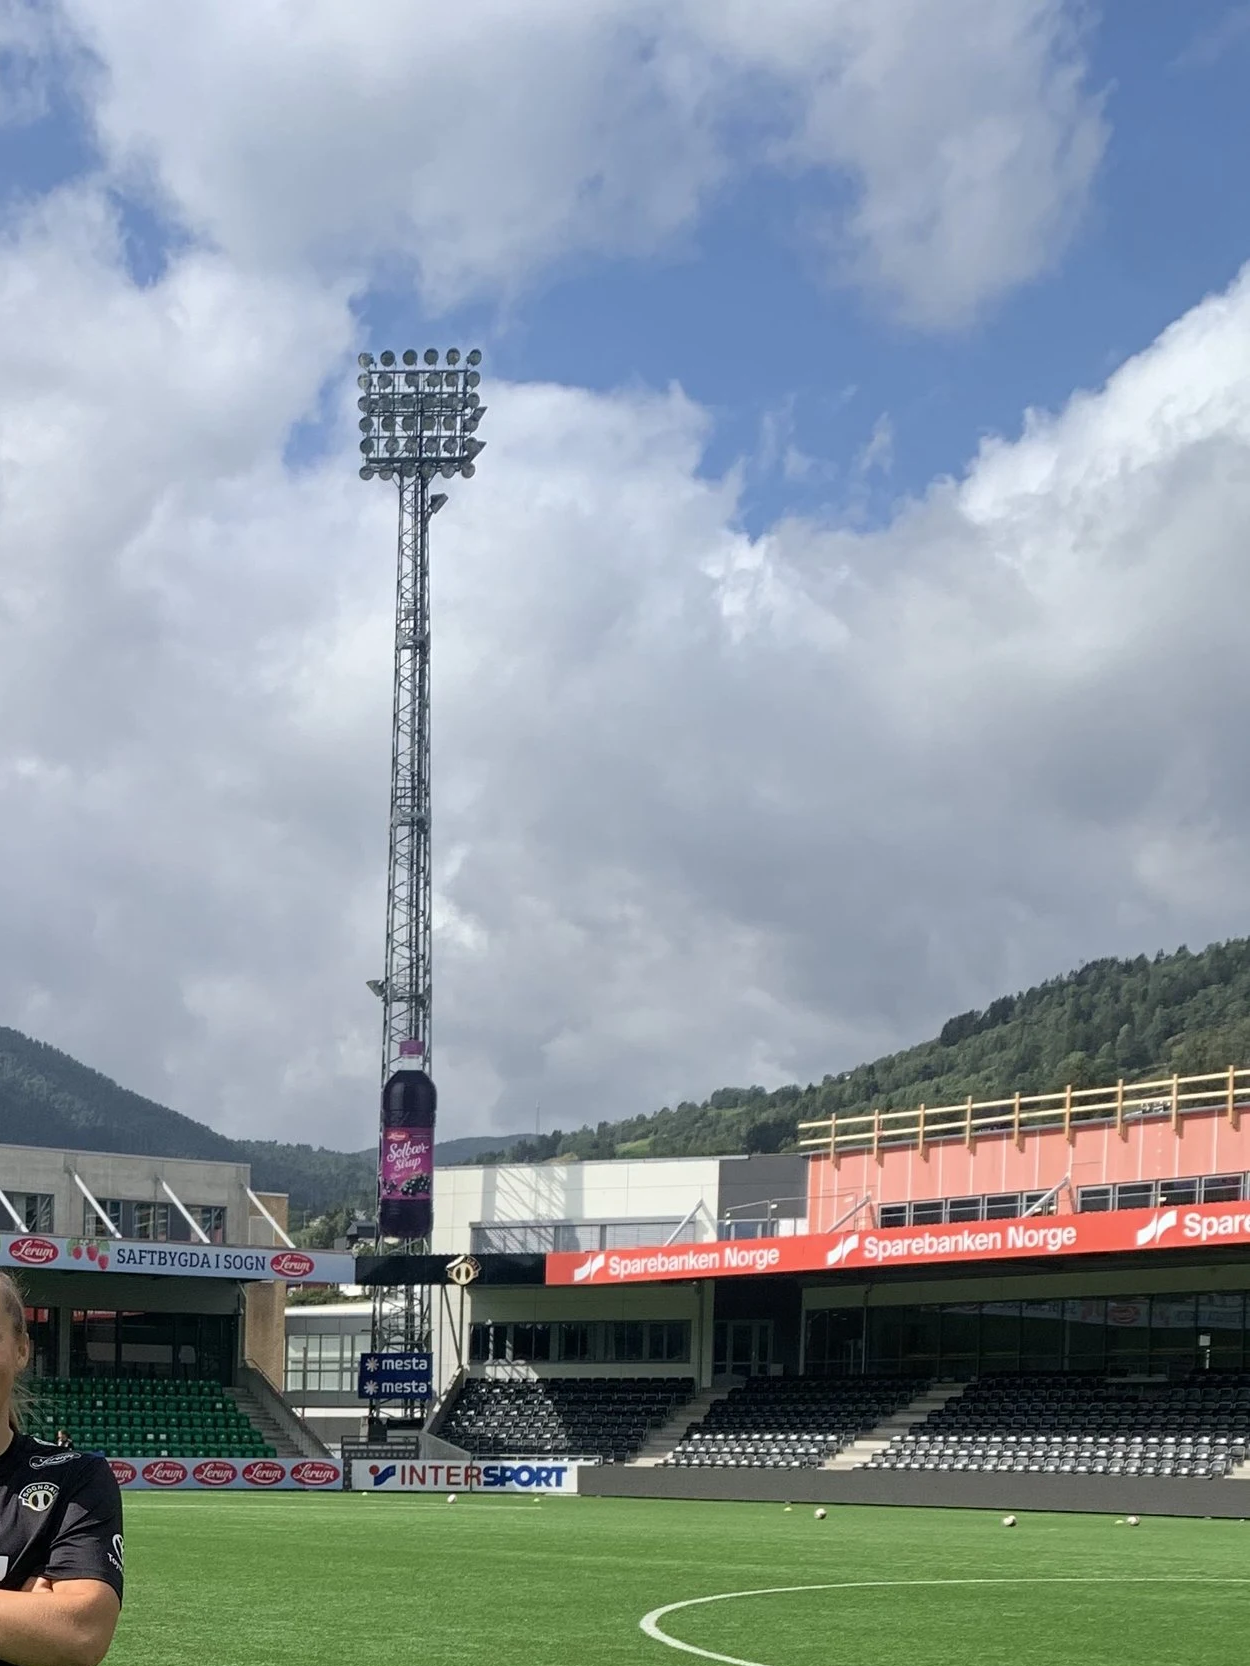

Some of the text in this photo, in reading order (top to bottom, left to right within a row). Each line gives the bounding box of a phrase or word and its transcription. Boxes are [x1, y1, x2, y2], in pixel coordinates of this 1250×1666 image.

[11, 1239, 54, 1263] Lerum
[864, 1224, 1078, 1262] Sparebanken Norge
[117, 1248, 266, 1272] SAFTBYGDA I SOGN
[271, 1253, 312, 1276] Lerum
[608, 1247, 780, 1279] Sparebanken Norge
[381, 1357, 428, 1371] mesta
[381, 1380, 428, 1393] mesta
[145, 1461, 183, 1484] Lerum
[195, 1461, 233, 1484] Lerum
[244, 1461, 282, 1484] Lerum
[293, 1461, 334, 1485] Lerum
[401, 1464, 568, 1488] INTERSPORT
